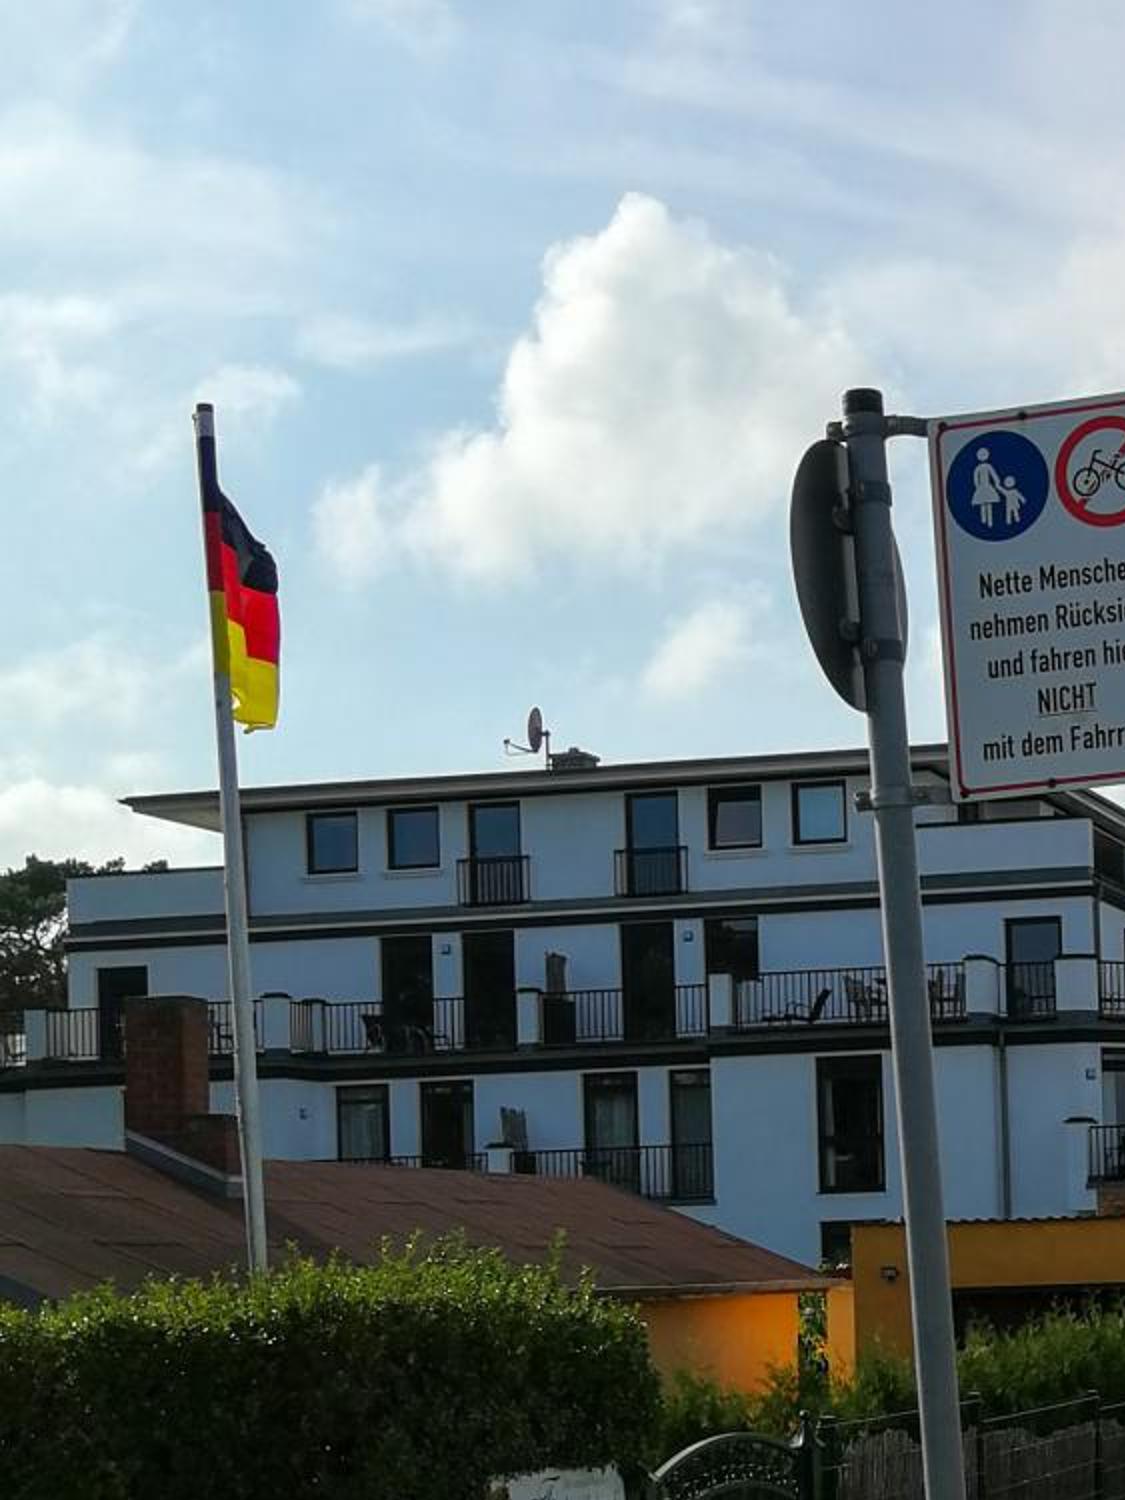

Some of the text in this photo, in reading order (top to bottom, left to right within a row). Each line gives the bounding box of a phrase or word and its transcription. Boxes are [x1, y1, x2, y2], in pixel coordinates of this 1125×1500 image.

[979, 572, 1032, 599] Nette
[970, 612, 1049, 640] nehmen
[988, 652, 1024, 679] und
[1030, 646, 1096, 674] fahren
[1037, 682, 1097, 714] NICHT
[983, 734, 1015, 762] mit
[1021, 731, 1063, 757] dem
